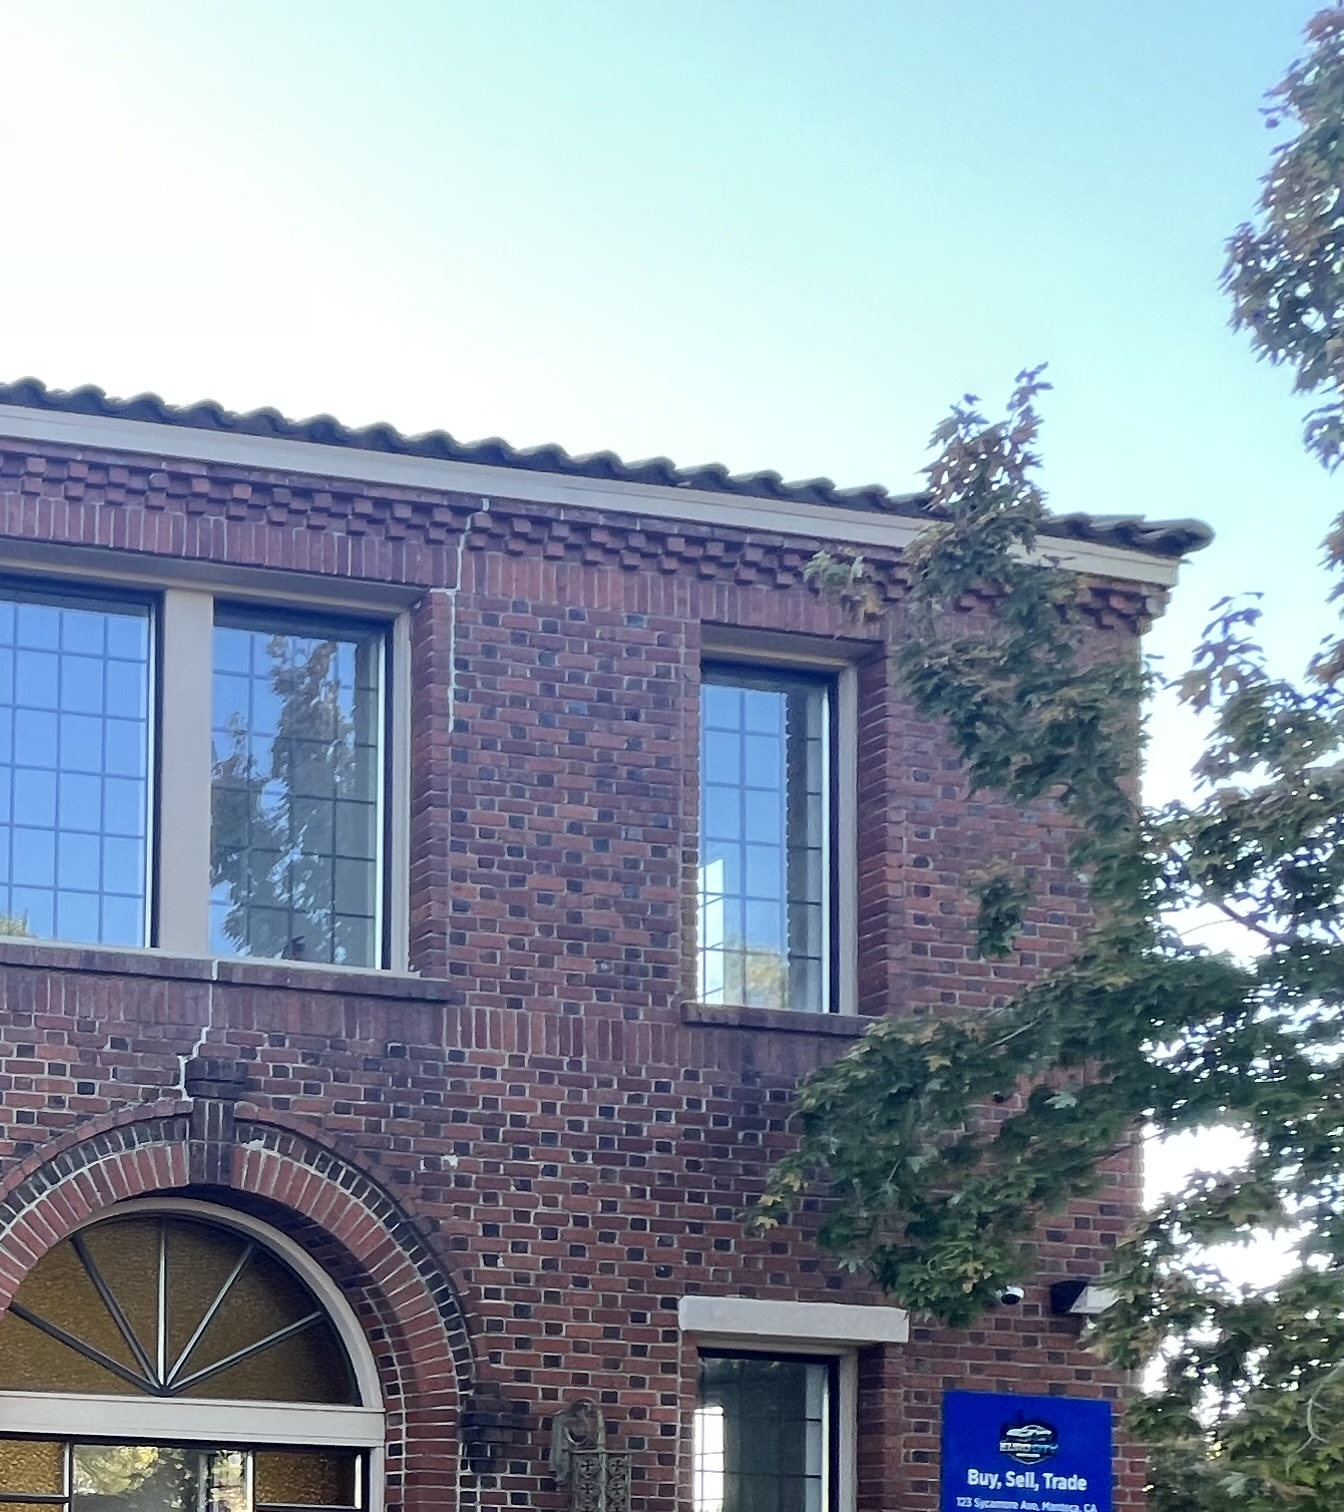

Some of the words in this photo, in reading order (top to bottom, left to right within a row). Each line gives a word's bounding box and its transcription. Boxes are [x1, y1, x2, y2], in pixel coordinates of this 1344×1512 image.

[967, 1468, 1002, 1489] Buy,
[1005, 1470, 1040, 1491] Sell,
[1042, 1472, 1088, 1491] Trade
